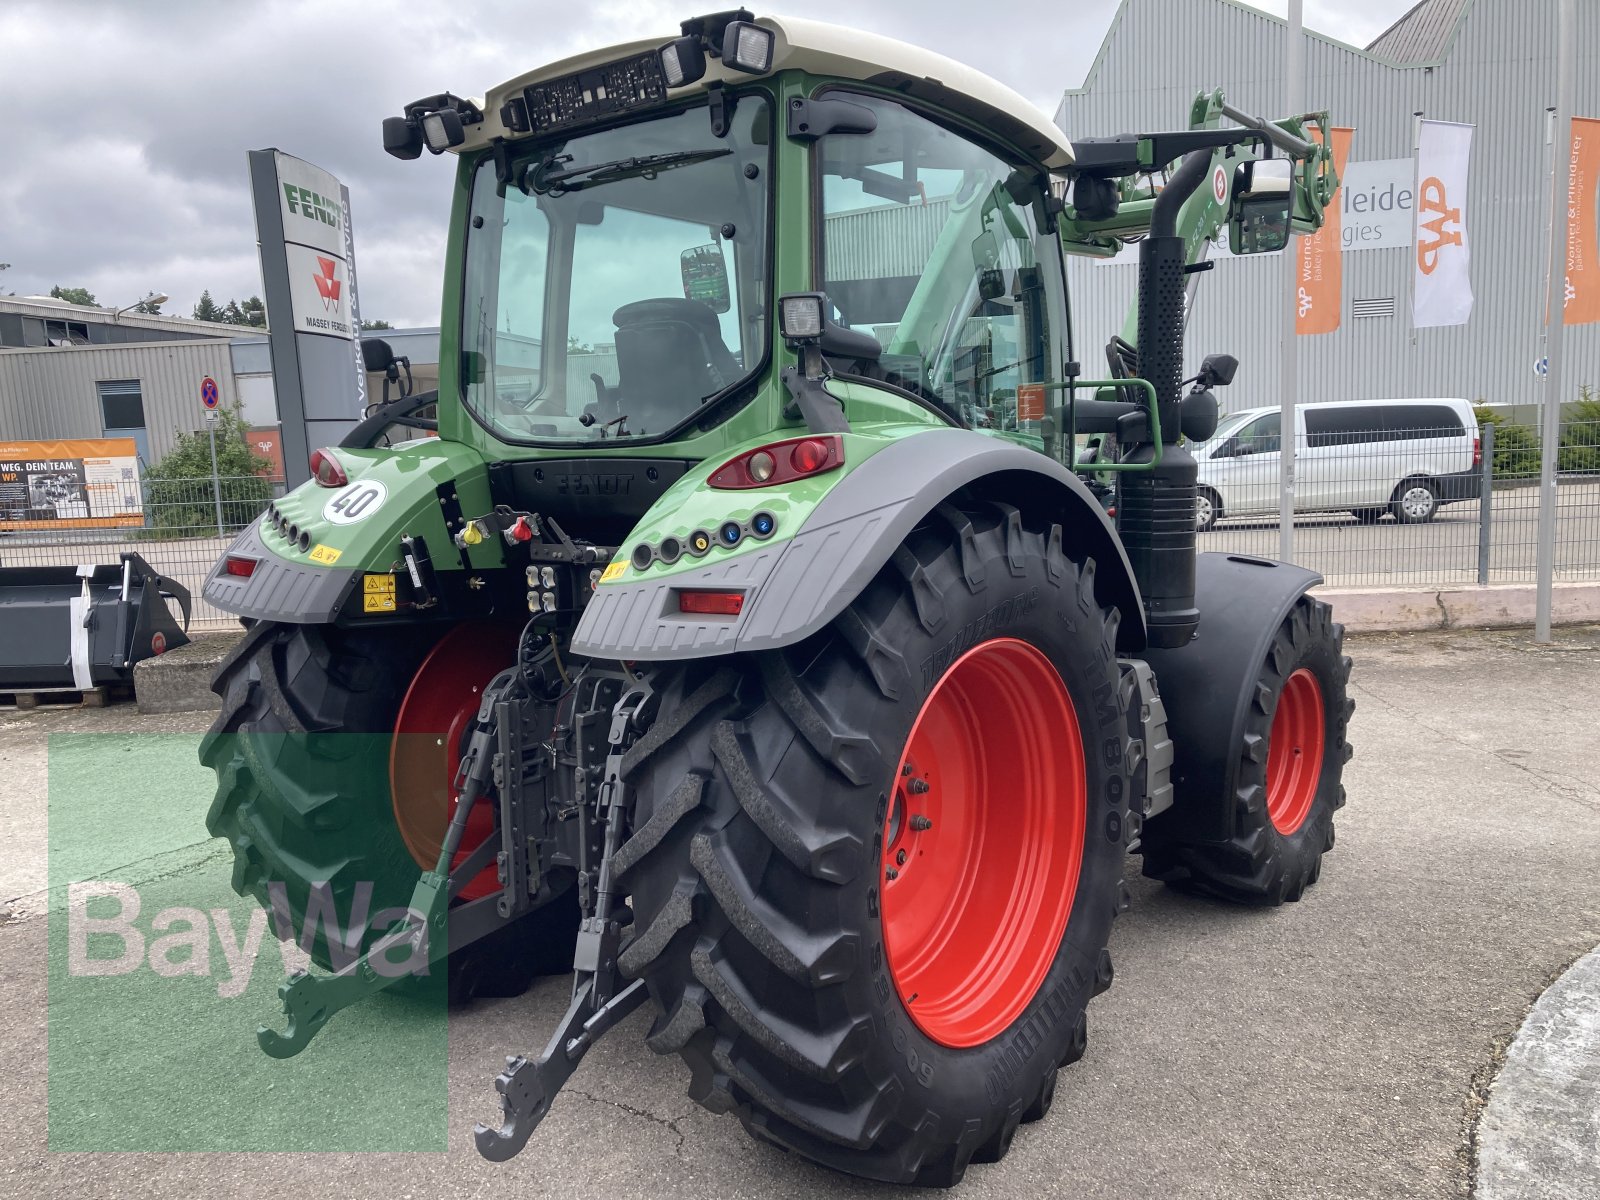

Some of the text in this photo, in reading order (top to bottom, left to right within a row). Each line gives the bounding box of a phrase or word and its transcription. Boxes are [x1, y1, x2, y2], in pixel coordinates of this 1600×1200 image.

[283, 182, 342, 231] FENDT
[1344, 182, 1413, 214] leide
[306, 316, 330, 329] MASSEY
[1, 462, 24, 472] WEG.
[26, 462, 47, 471] DEIN
[49, 461, 77, 471] TEAM.
[2, 472, 18, 481] WP.
[553, 473, 634, 497] FENDT
[331, 484, 379, 518] 40
